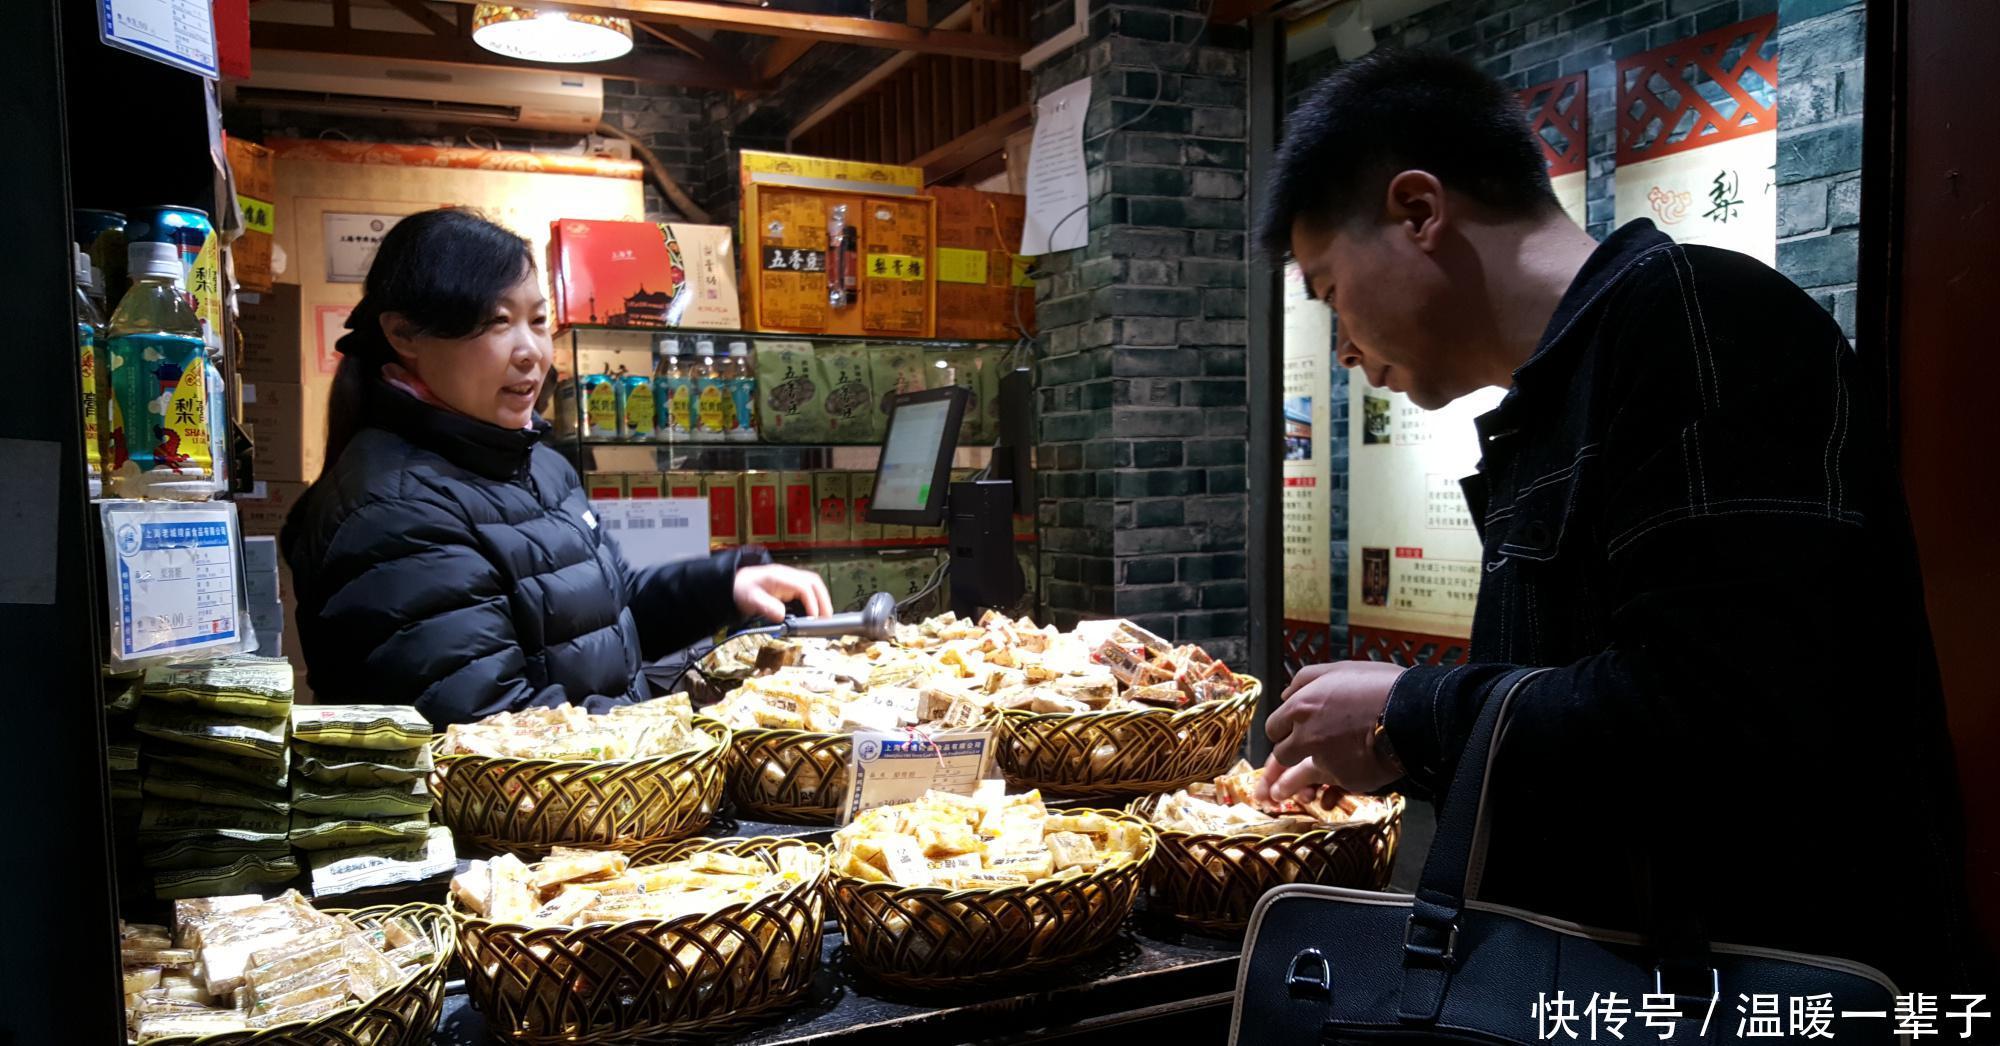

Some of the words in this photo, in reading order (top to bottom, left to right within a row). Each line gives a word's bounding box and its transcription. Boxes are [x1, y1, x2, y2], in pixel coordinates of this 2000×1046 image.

[767, 249, 820, 271] 五香豆
[873, 257, 922, 276] 梨膏糖
[780, 365, 801, 418] 五香豆
